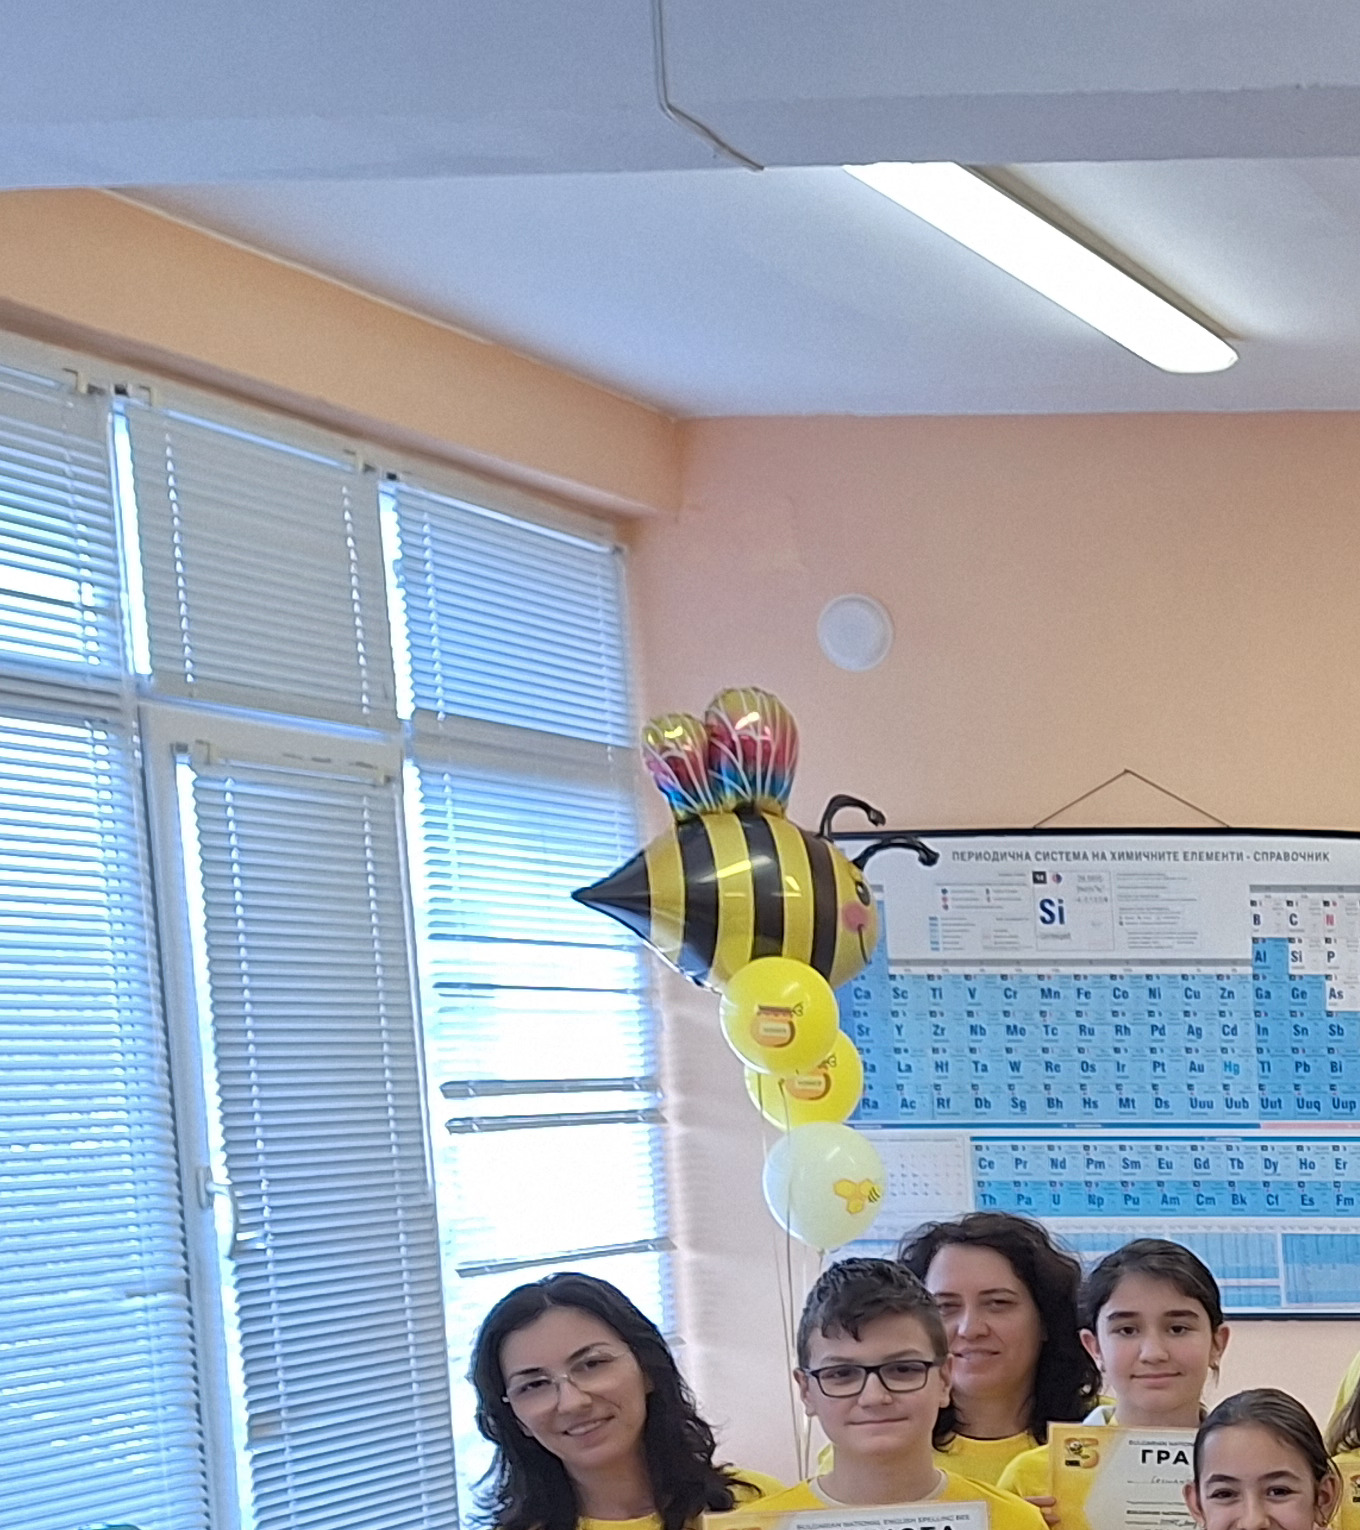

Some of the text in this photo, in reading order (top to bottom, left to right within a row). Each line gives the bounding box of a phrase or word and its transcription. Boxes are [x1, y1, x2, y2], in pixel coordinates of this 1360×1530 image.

[952, 851, 1330, 862] ПЕРИОДИЧНА СИСТЕМА НА ХИМИЧНИТЕ ЕЛЕМЕНТИ СПРАВОЧНИК
[1039, 899, 1065, 924] Si
[1253, 914, 1261, 925] B
[1289, 914, 1298, 925] C
[1326, 914, 1334, 925] N
[1255, 951, 1266, 962] Al
[1291, 951, 1302, 962] Si
[1327, 952, 1335, 963] P
[854, 988, 871, 999] Ca
[1041, 988, 1060, 999] Mn
[1077, 988, 1091, 999] Fe
[1112, 988, 1129, 999] Co
[1149, 988, 1161, 999] Ni
[1184, 988, 1200, 999] Cu
[1220, 988, 1235, 999] Zn
[1256, 988, 1271, 999] Ga
[1329, 988, 1344, 1000] As
[1187, 1025, 1202, 1039] Ag
[1222, 1025, 1238, 1036] Cd
[1293, 1025, 1309, 1036] Sn
[1224, 1061, 1240, 1075] Hg
[1295, 1061, 1310, 1073] Pb
[979, 1158, 995, 1169] Ce
[1051, 1158, 1066, 1169] Nd
[1158, 1159, 1173, 1170] Eu
[1194, 1158, 1210, 1170] Gd
